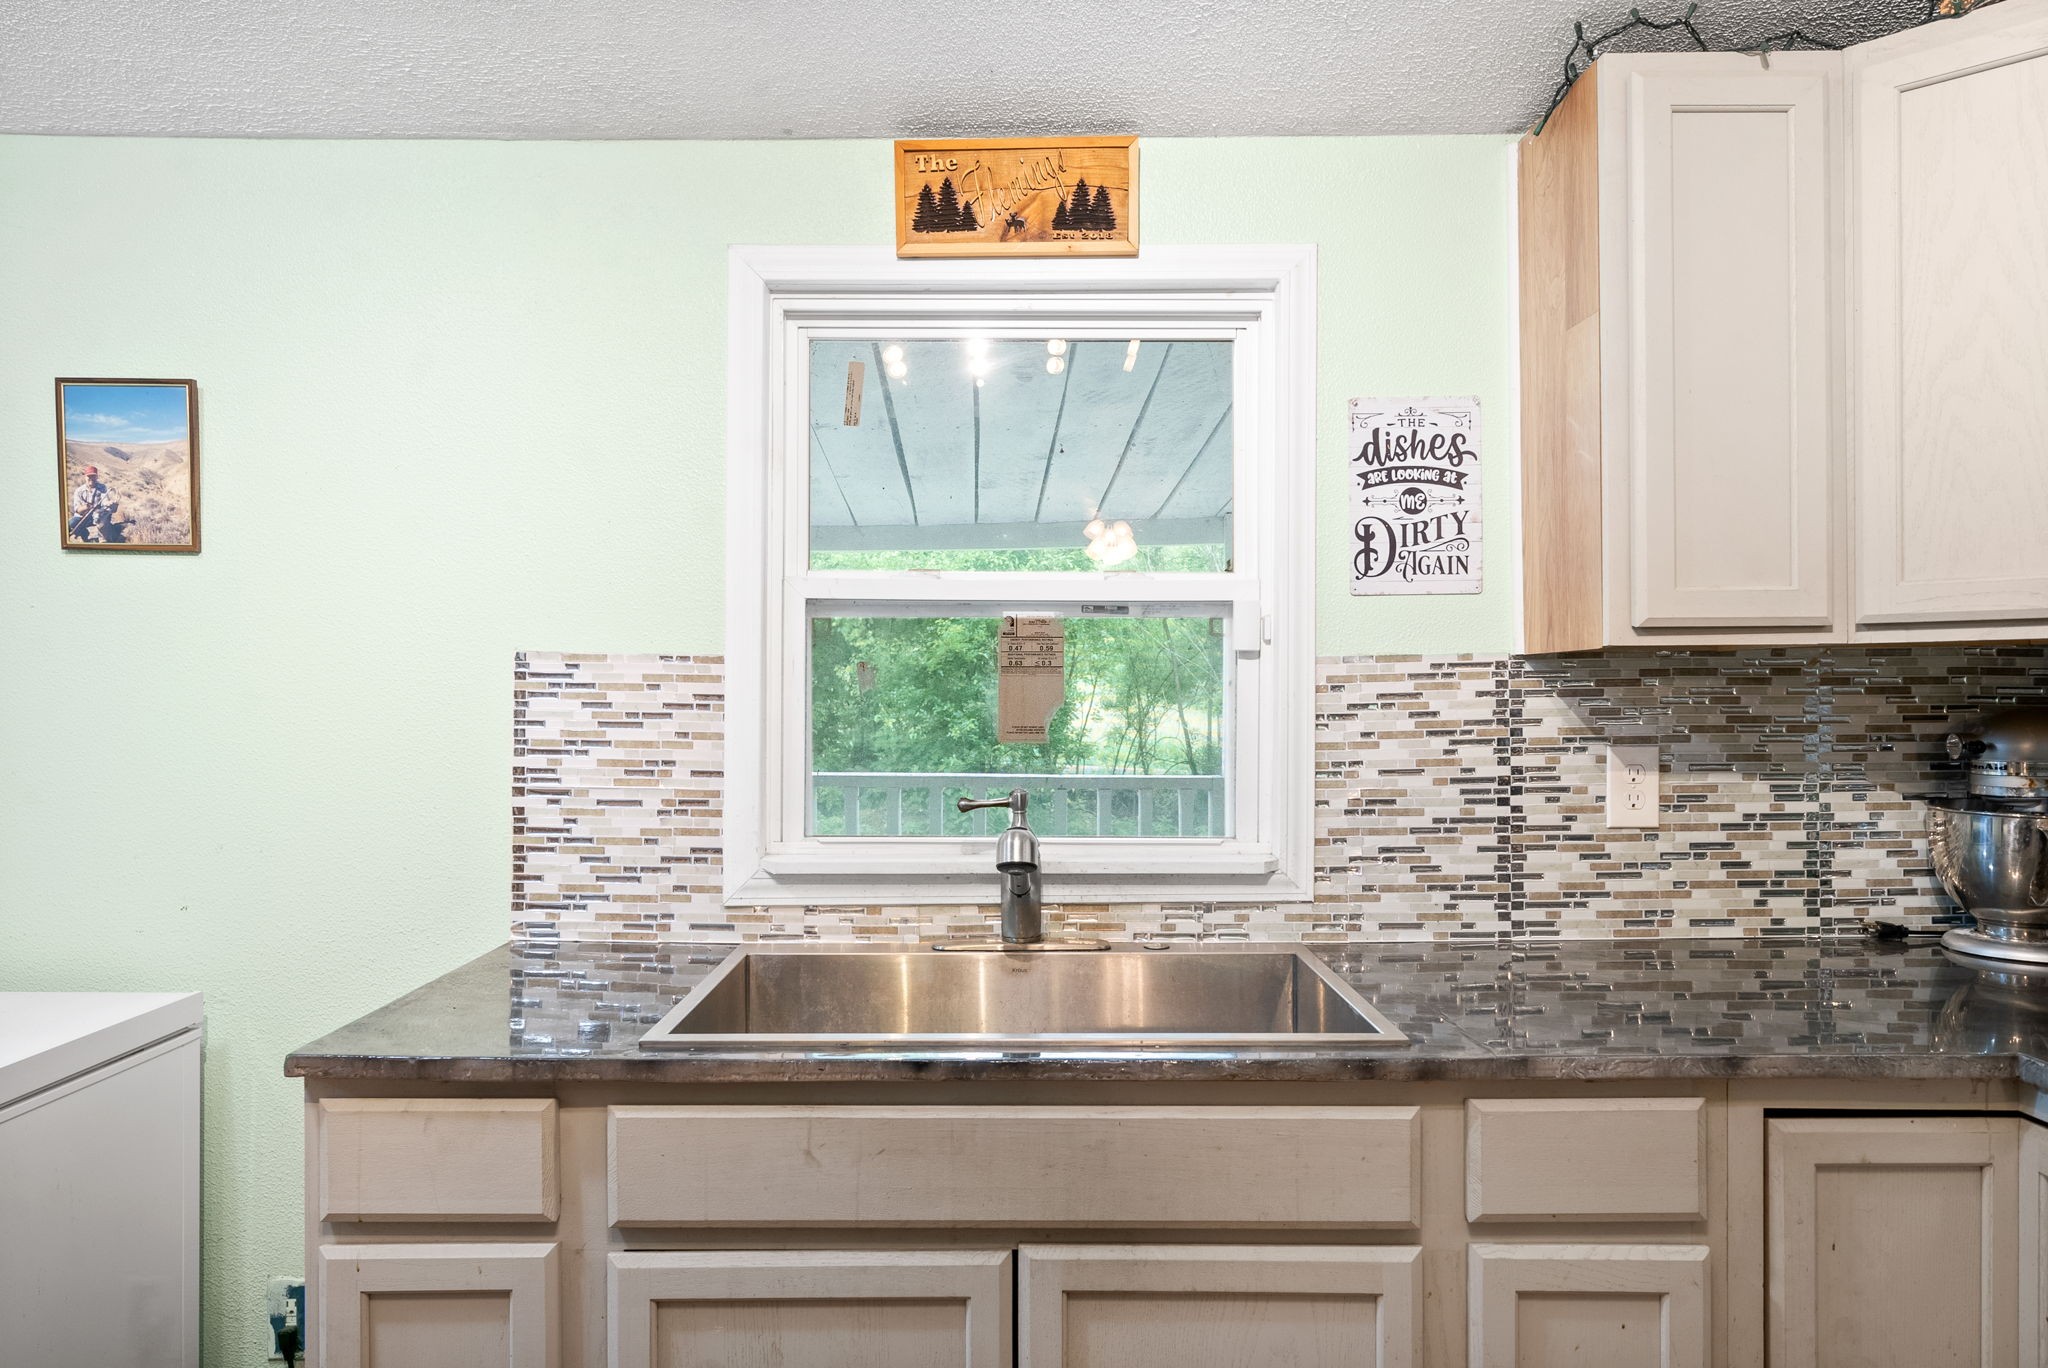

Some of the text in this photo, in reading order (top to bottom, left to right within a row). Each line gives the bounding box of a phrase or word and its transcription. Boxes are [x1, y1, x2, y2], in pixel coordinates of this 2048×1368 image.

[914, 150, 1067, 229] The Flemings
[1397, 418, 1426, 428] THE
[1352, 427, 1478, 467] dishes
[1354, 510, 1470, 581] DIRTY
[1395, 550, 1470, 583] AGAIN
